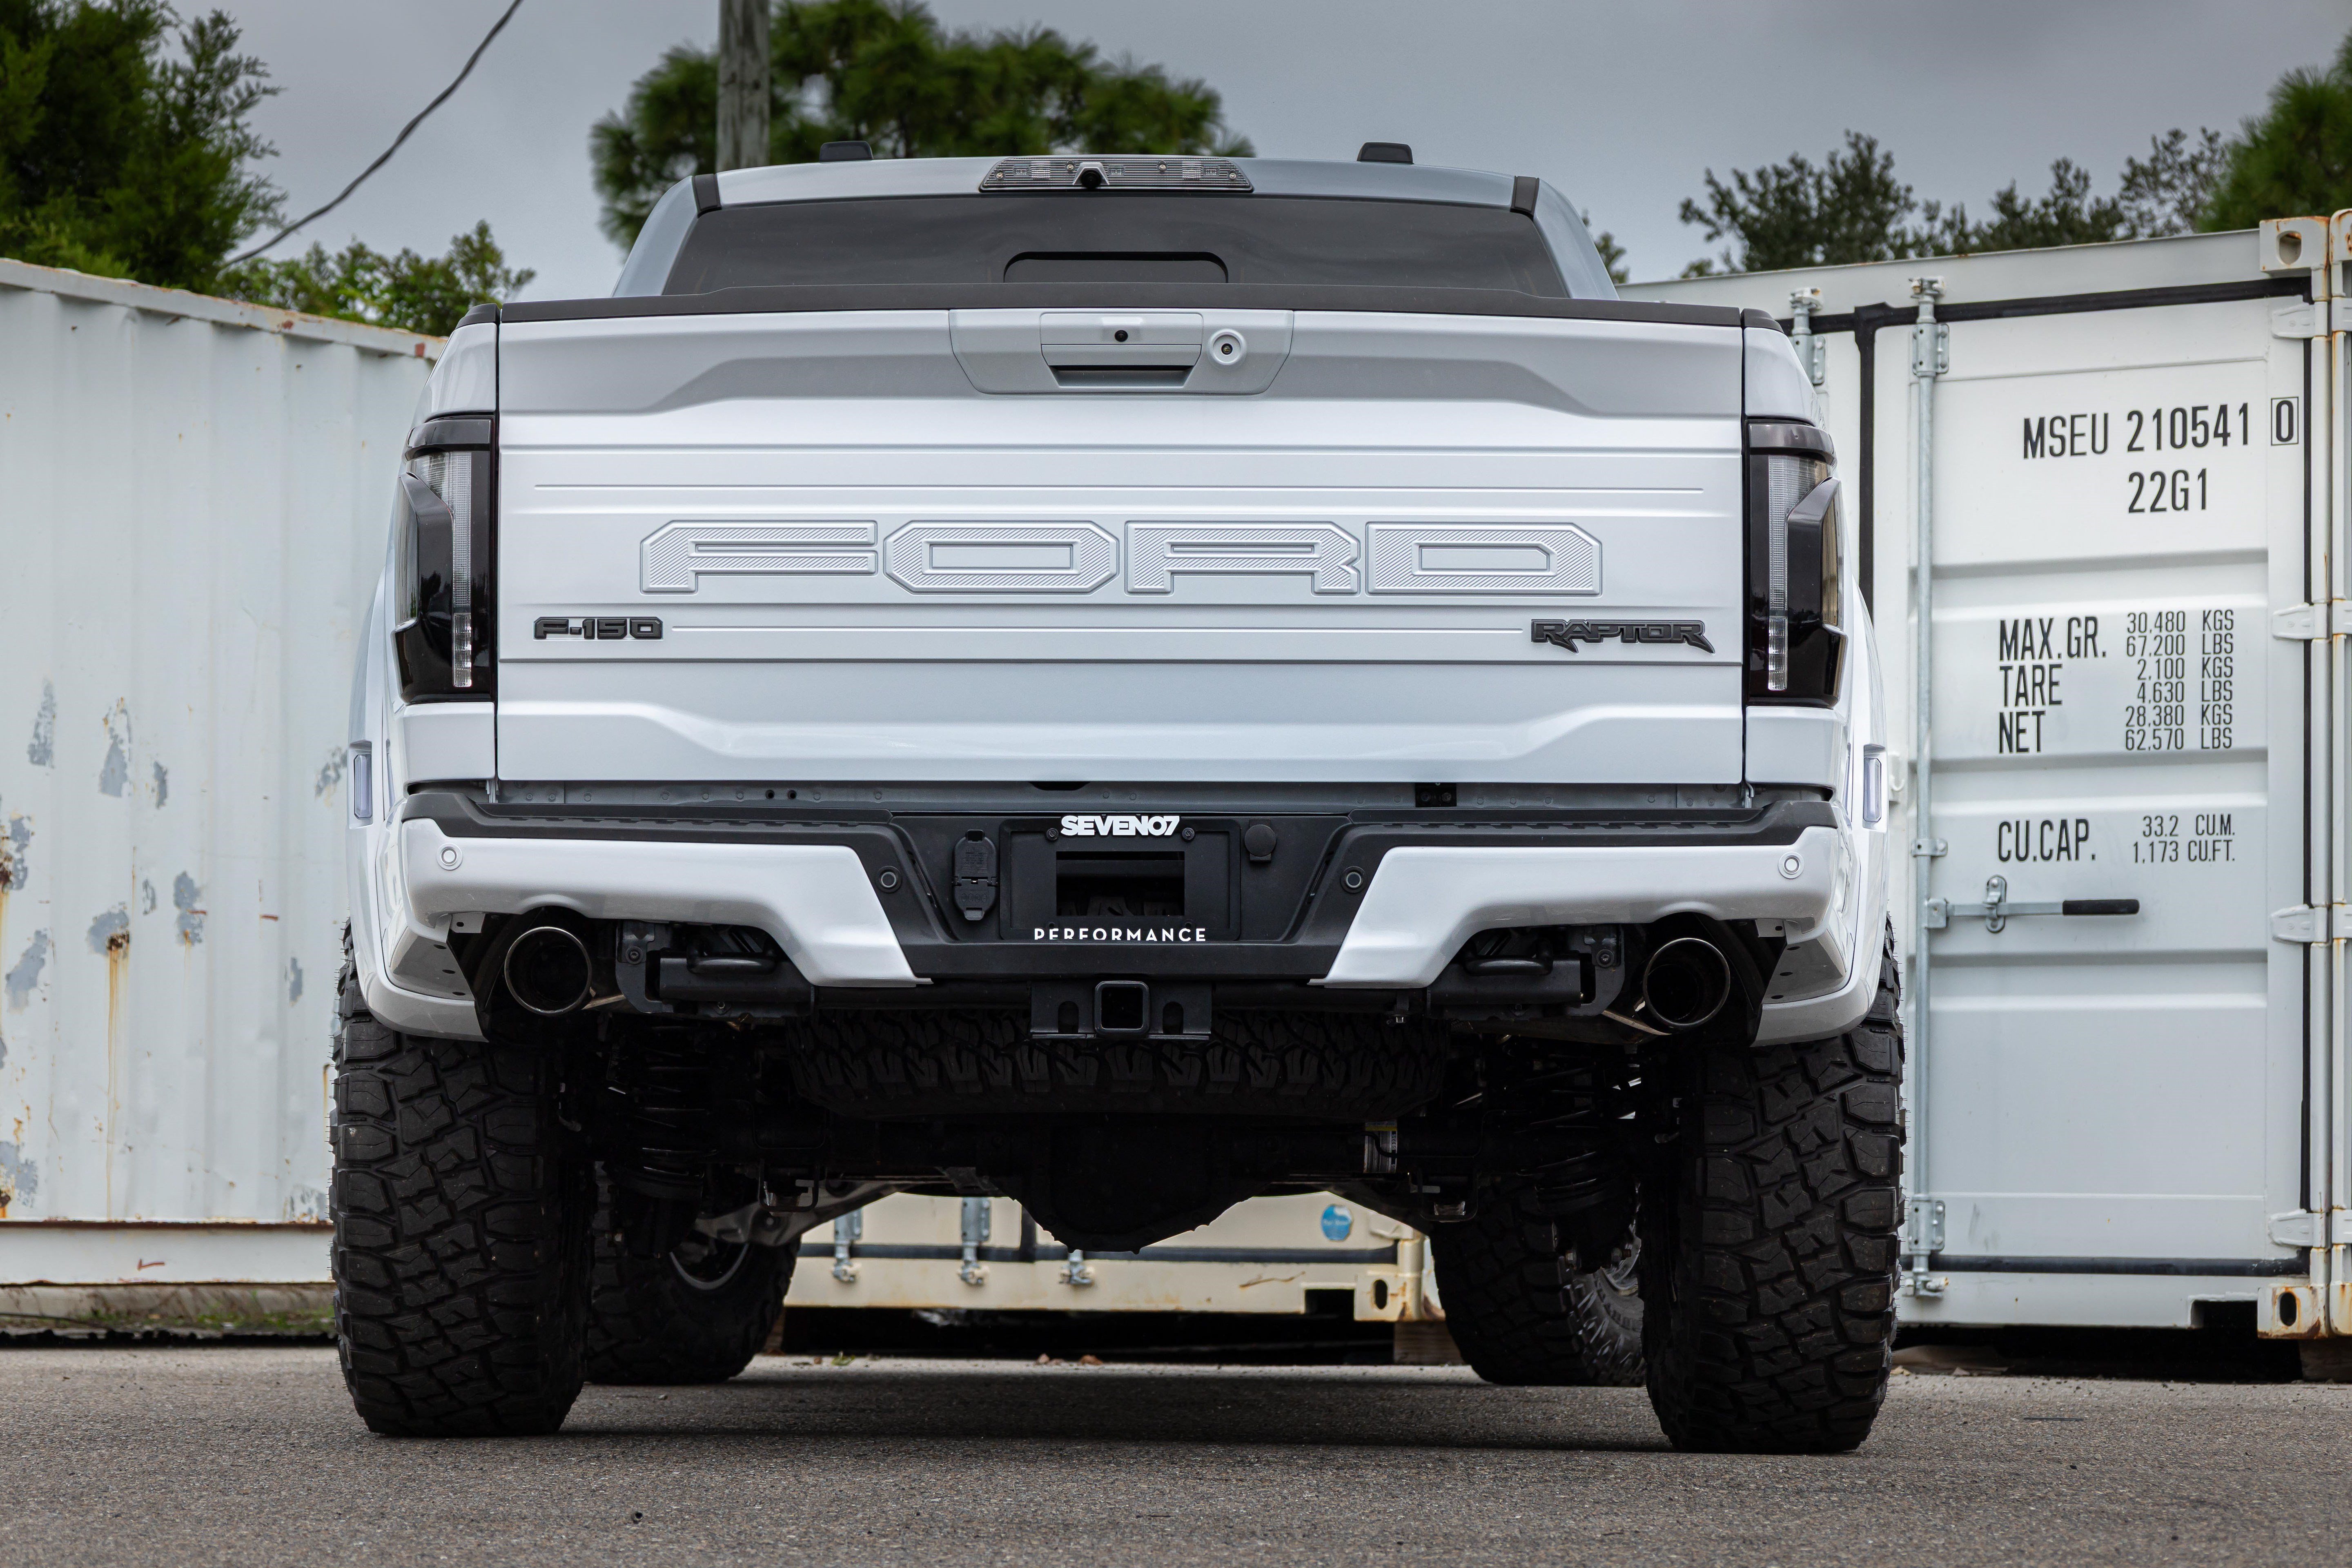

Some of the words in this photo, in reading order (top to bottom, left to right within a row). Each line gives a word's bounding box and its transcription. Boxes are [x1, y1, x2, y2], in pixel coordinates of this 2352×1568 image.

[2024, 413, 2109, 459] MSEU
[2127, 403, 2248, 452] 210541
[2275, 399, 2294, 442] 0
[2128, 468, 2207, 513] 22G1
[640, 520, 1602, 596] FORD
[533, 617, 663, 640] F-150
[1531, 619, 1715, 654] RAPTOR
[2000, 616, 2106, 661] MAX.GR.
[2127, 610, 2185, 634] 30,480
[2203, 609, 2234, 632] KGS
[2127, 634, 2185, 657] 67,200
[2202, 633, 2234, 655] LBS
[2000, 663, 2062, 707] TARE
[2137, 657, 2185, 681] 2,100
[2202, 656, 2234, 679] KGS
[2137, 681, 2185, 704] 4,630
[2201, 680, 2233, 702] LBS
[1999, 710, 2046, 754] NET
[2125, 704, 2184, 728] 28,380
[2201, 704, 2233, 726] KGS
[2125, 728, 2184, 751] 62,570
[2201, 727, 2233, 750] LBS
[2143, 815, 2179, 837] 33.2
[2133, 840, 2179, 864] 1,173
[1034, 928, 1206, 942] PERFORMANCE
